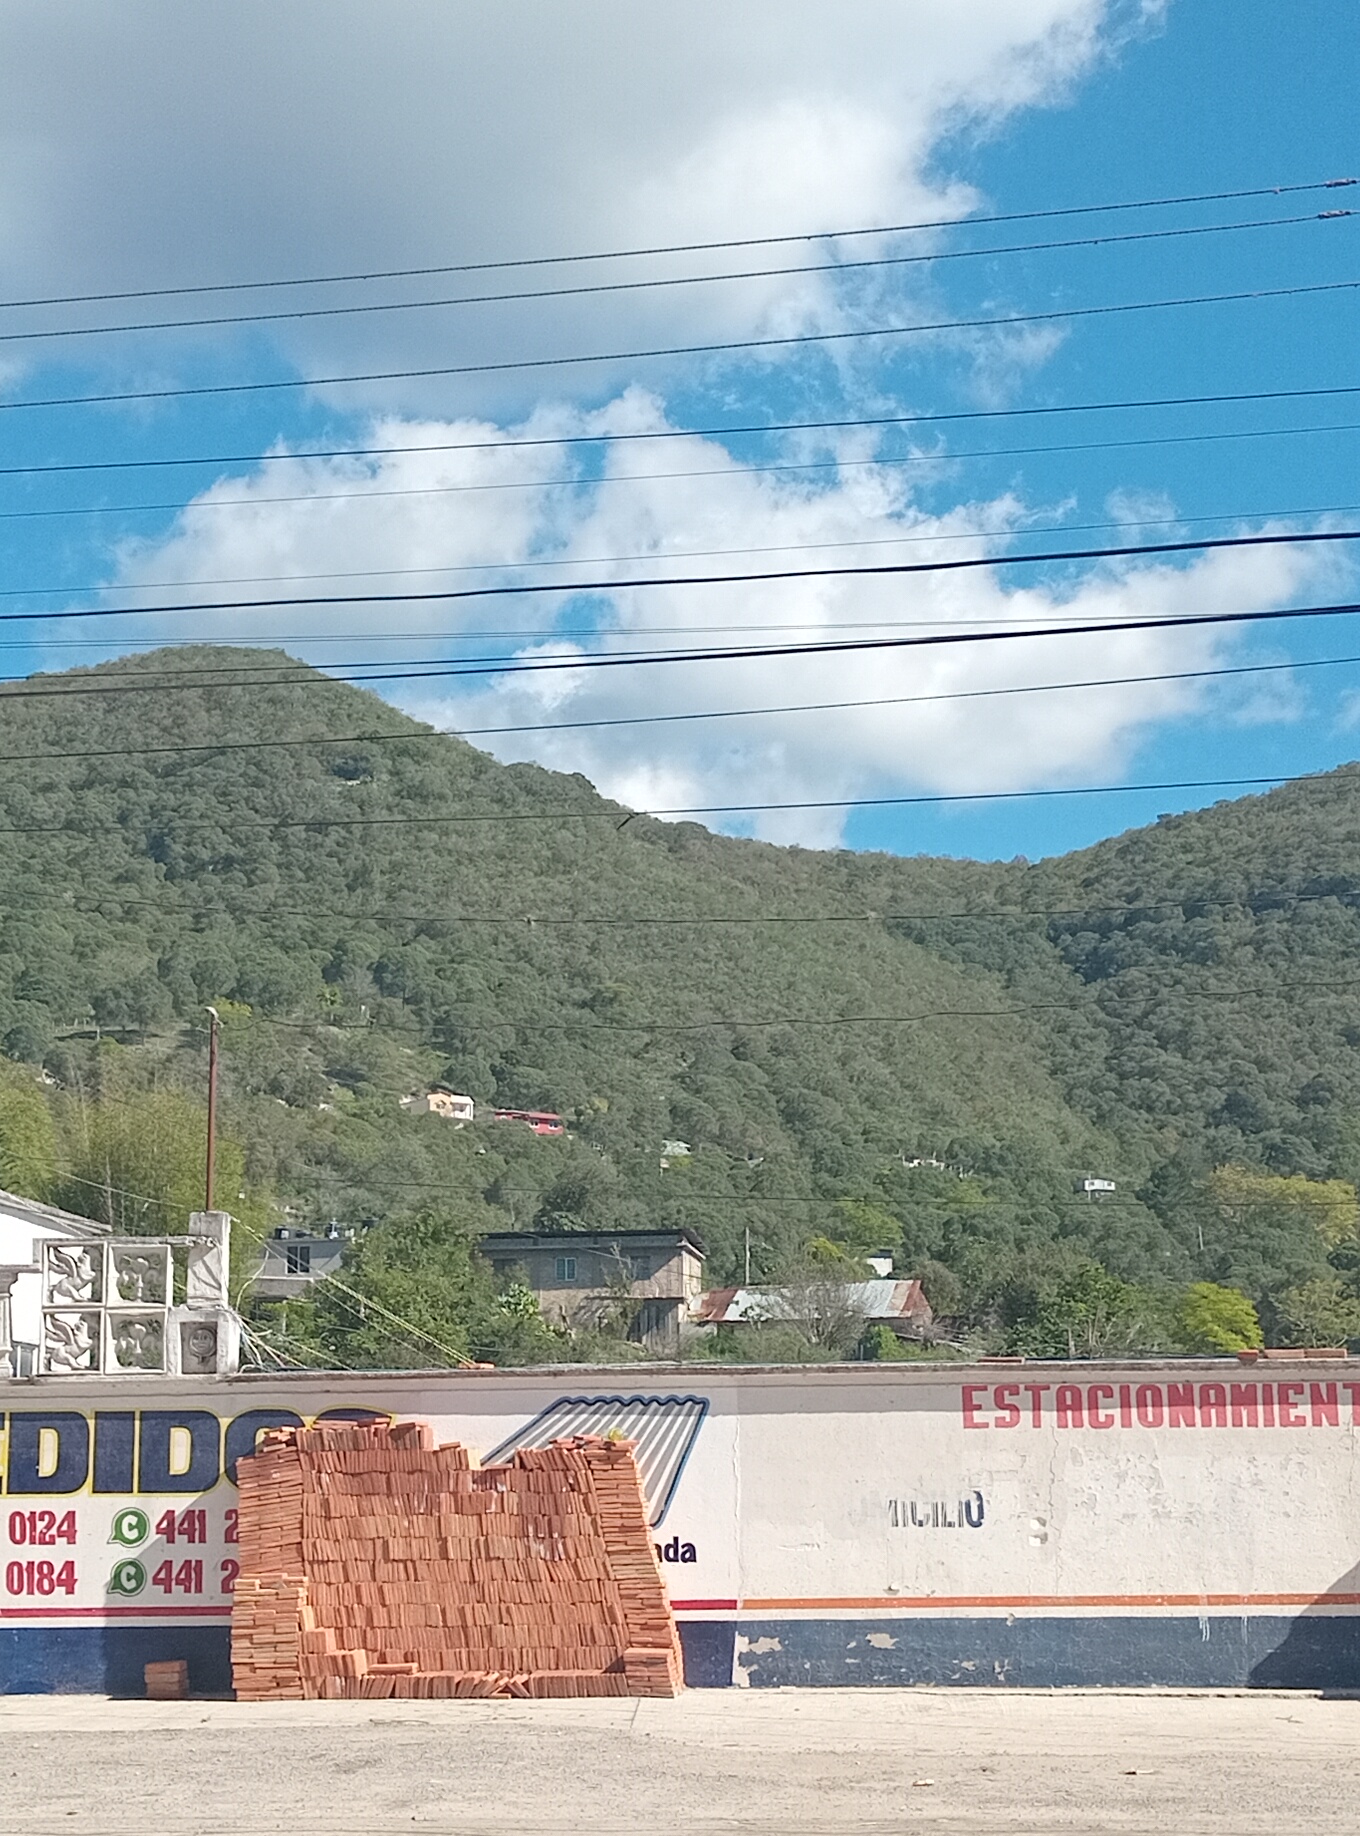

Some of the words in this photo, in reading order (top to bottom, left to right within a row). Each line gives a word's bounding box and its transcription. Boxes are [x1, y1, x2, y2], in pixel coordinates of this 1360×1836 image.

[8, 1510, 77, 1545] 0124
[154, 1509, 207, 1545] 441
[5, 1560, 78, 1596] 0184
[151, 1559, 203, 1595] 441
